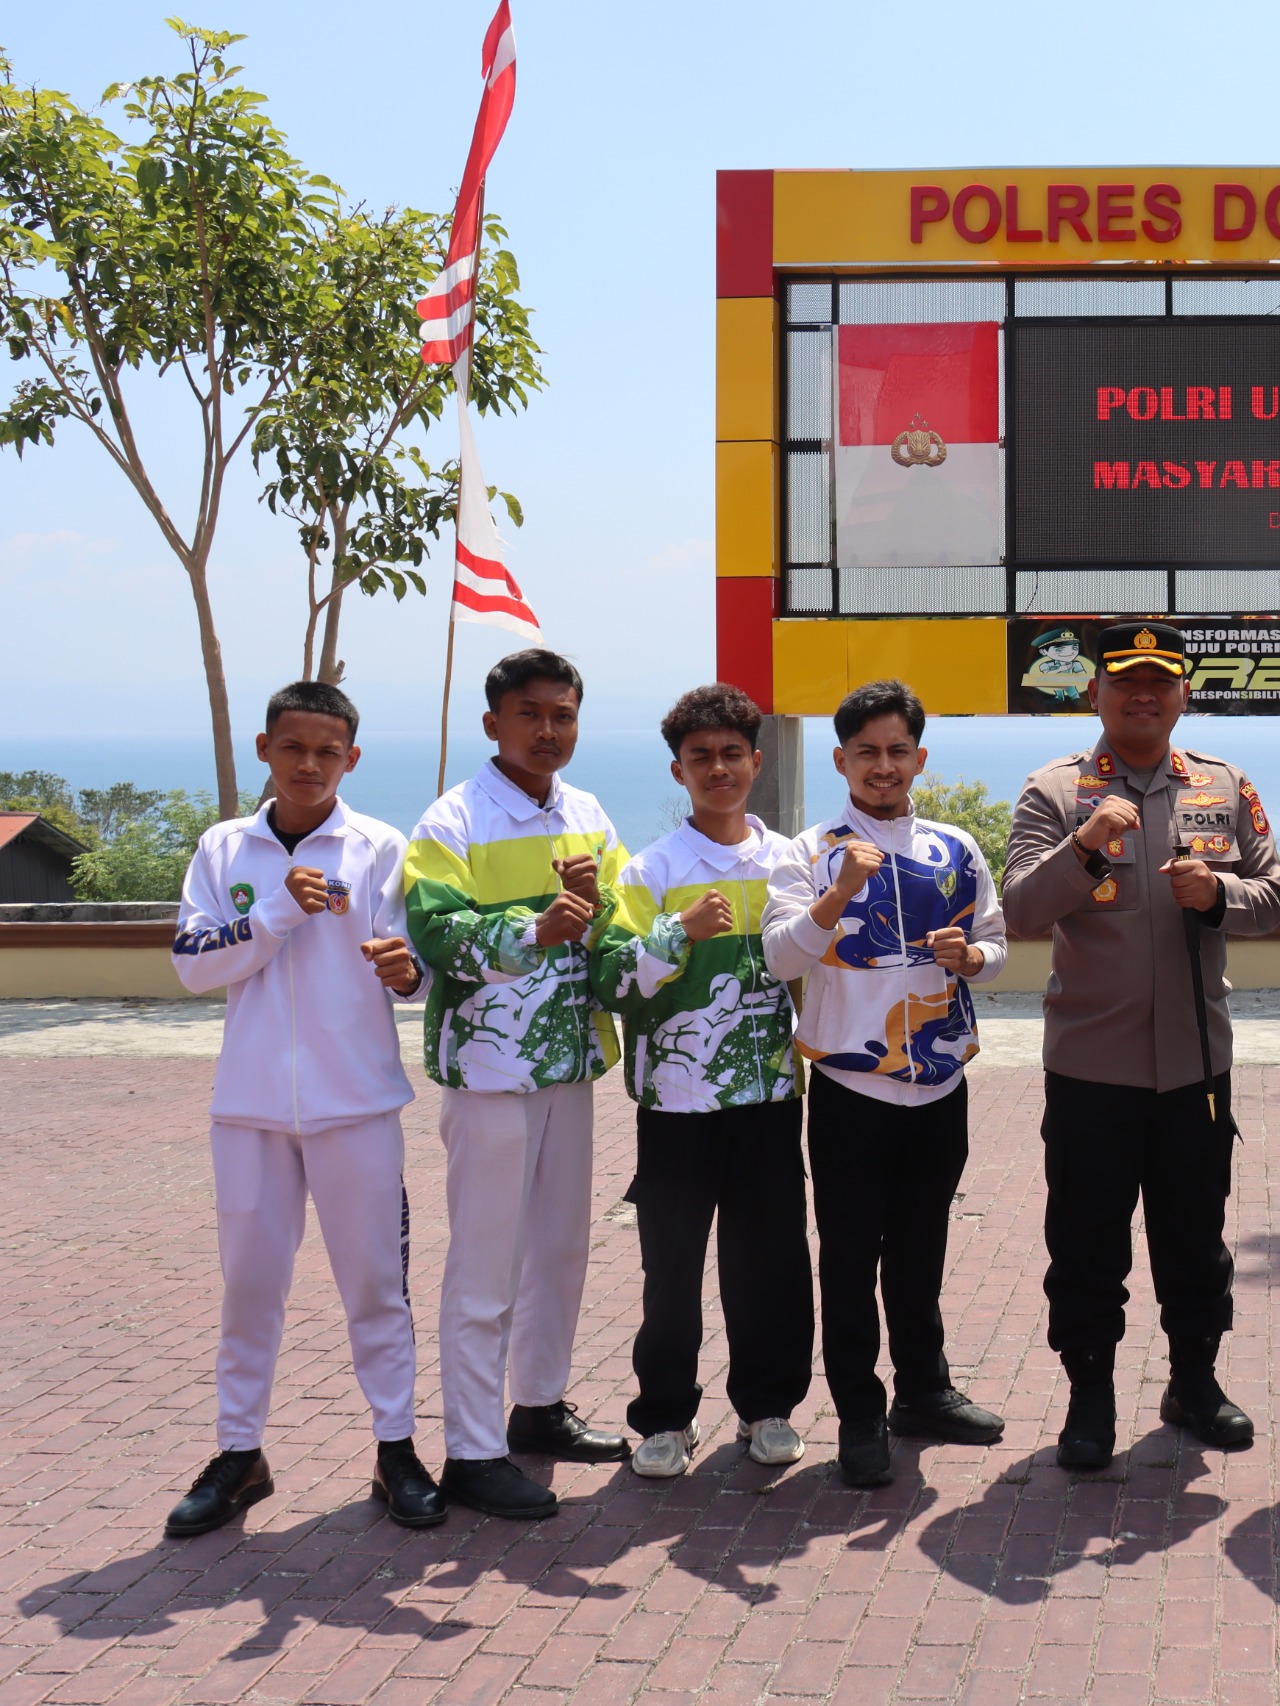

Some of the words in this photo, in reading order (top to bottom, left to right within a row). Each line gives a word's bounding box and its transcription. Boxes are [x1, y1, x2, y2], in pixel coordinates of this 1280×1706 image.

[909, 183, 1183, 244] POLRES
[1097, 386, 1232, 421] POLRI
[1185, 642, 1220, 654] UJU
[1225, 642, 1280, 654] POLRI
[1182, 813, 1231, 826] POLRI
[328, 880, 351, 889] KONI
